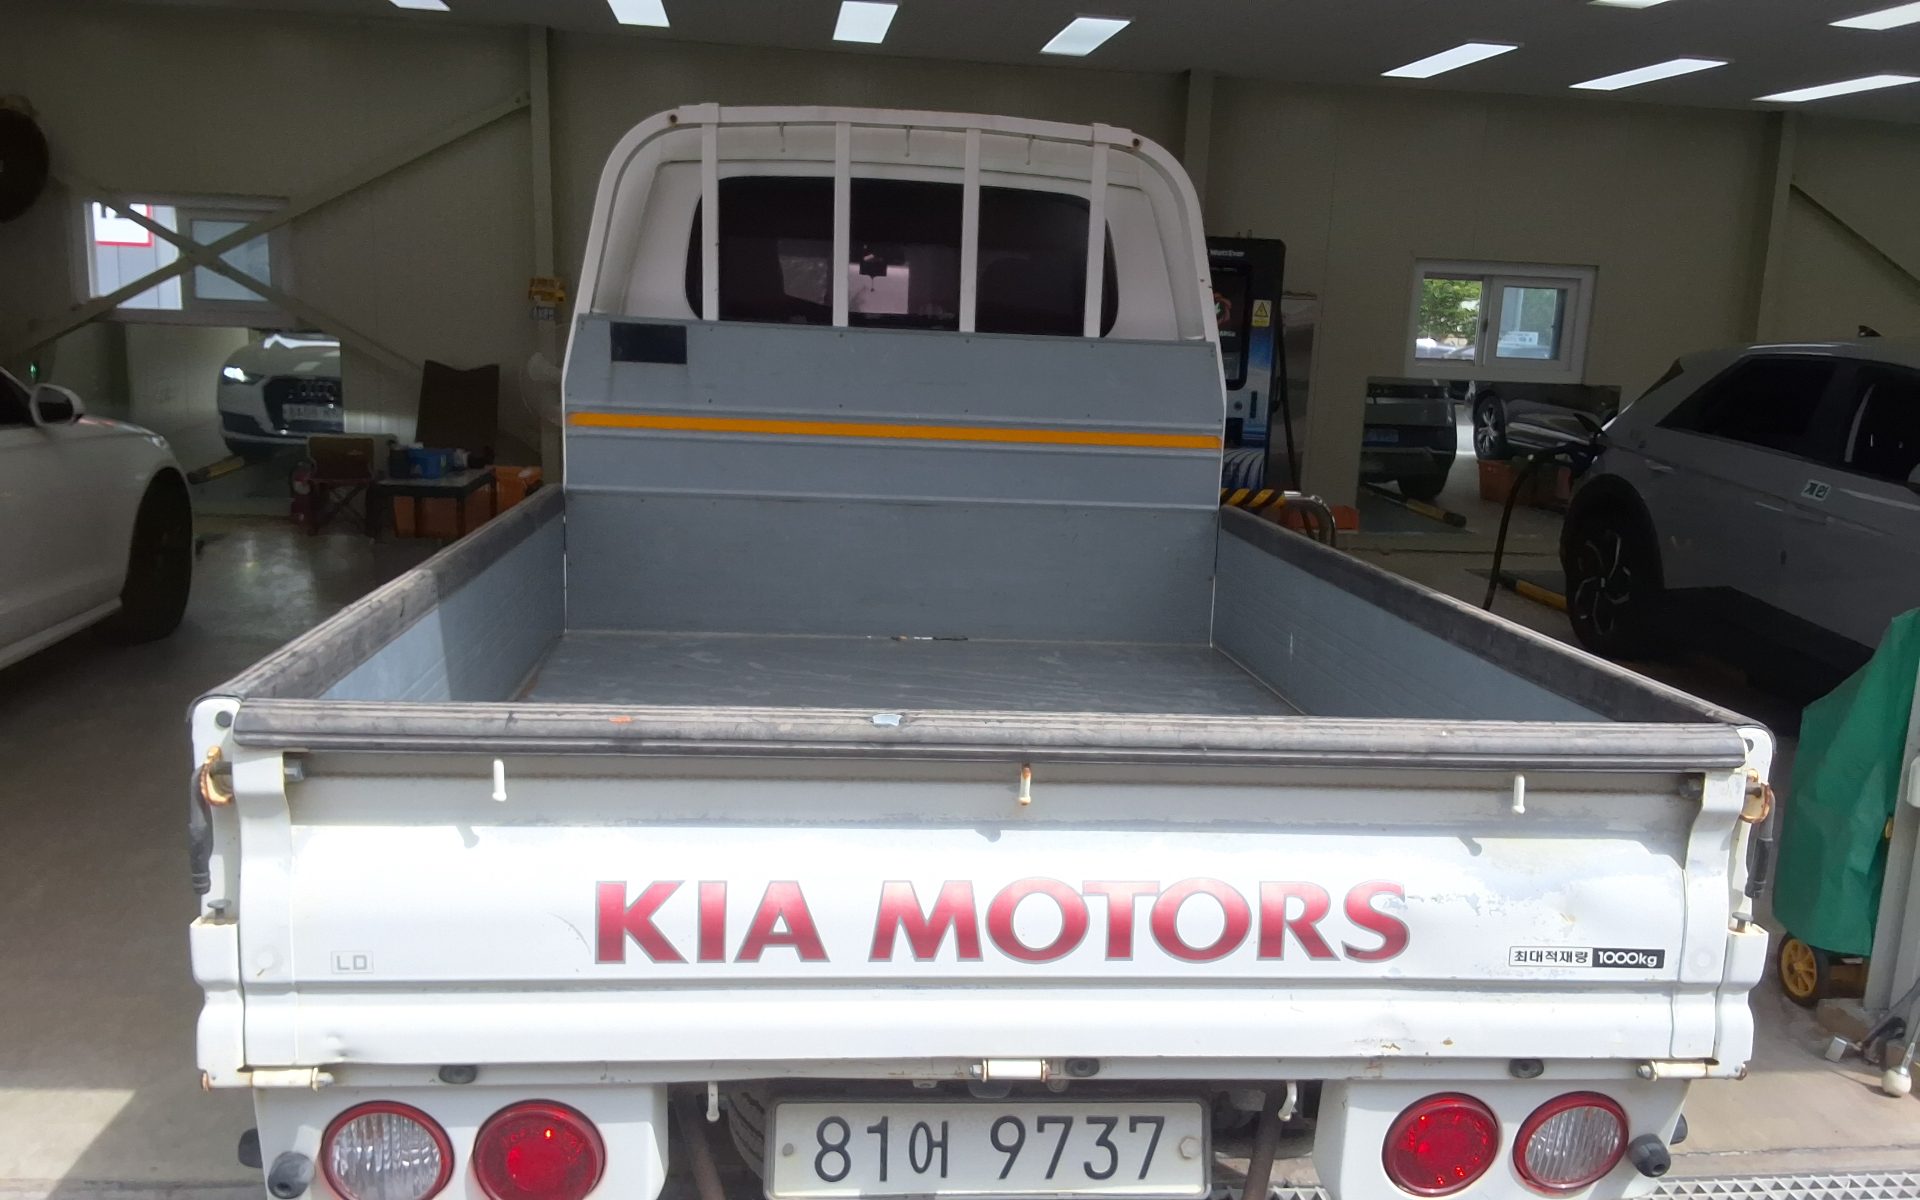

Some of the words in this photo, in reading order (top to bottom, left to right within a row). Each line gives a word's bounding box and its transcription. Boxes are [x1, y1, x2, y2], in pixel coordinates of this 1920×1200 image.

[595, 880, 830, 964] KIA
[867, 876, 1410, 964] MOTORS
[335, 955, 368, 970] LD
[1513, 949, 1589, 964] 최대적재량
[1597, 951, 1658, 968] 1000kg
[814, 1115, 949, 1183] 81어
[989, 1114, 1166, 1181] 9737
